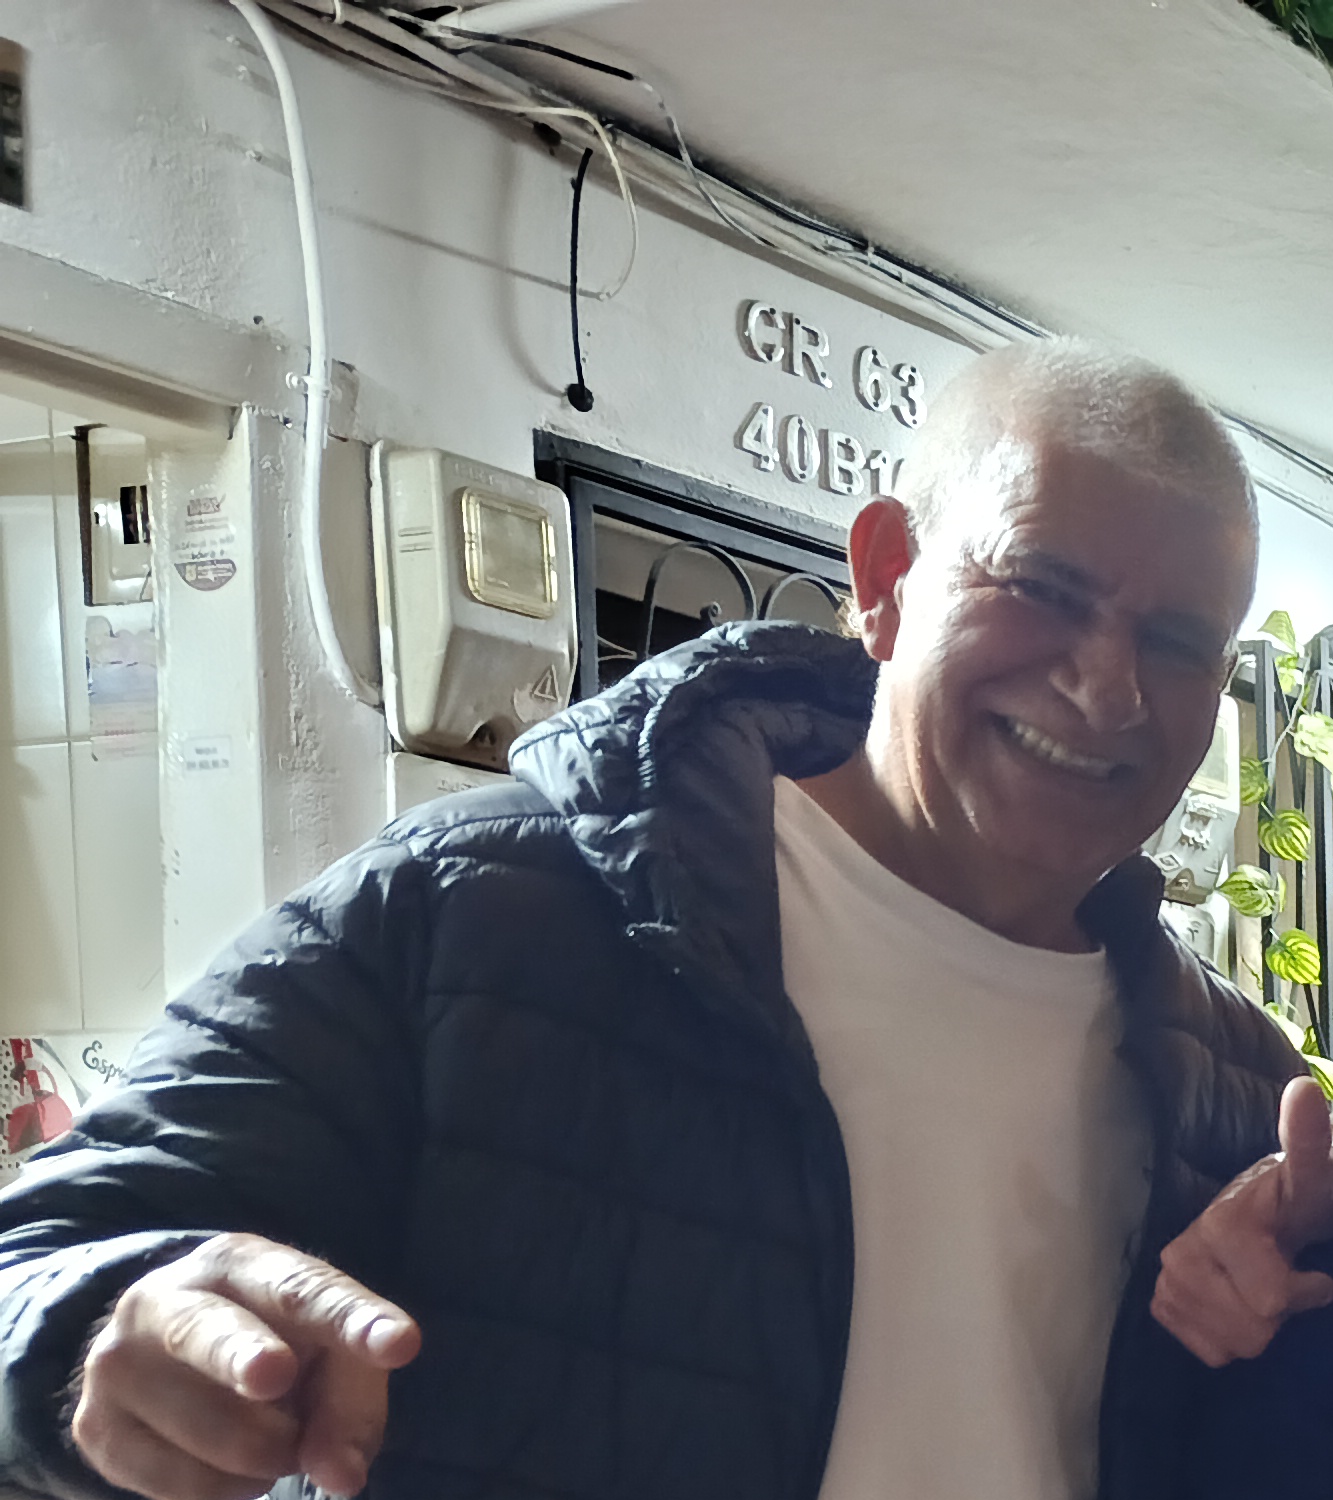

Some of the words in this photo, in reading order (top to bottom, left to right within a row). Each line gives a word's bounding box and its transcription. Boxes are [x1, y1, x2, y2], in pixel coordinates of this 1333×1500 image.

[739, 300, 833, 389] CR
[854, 346, 928, 430] 63
[737, 403, 905, 496] 40B1
